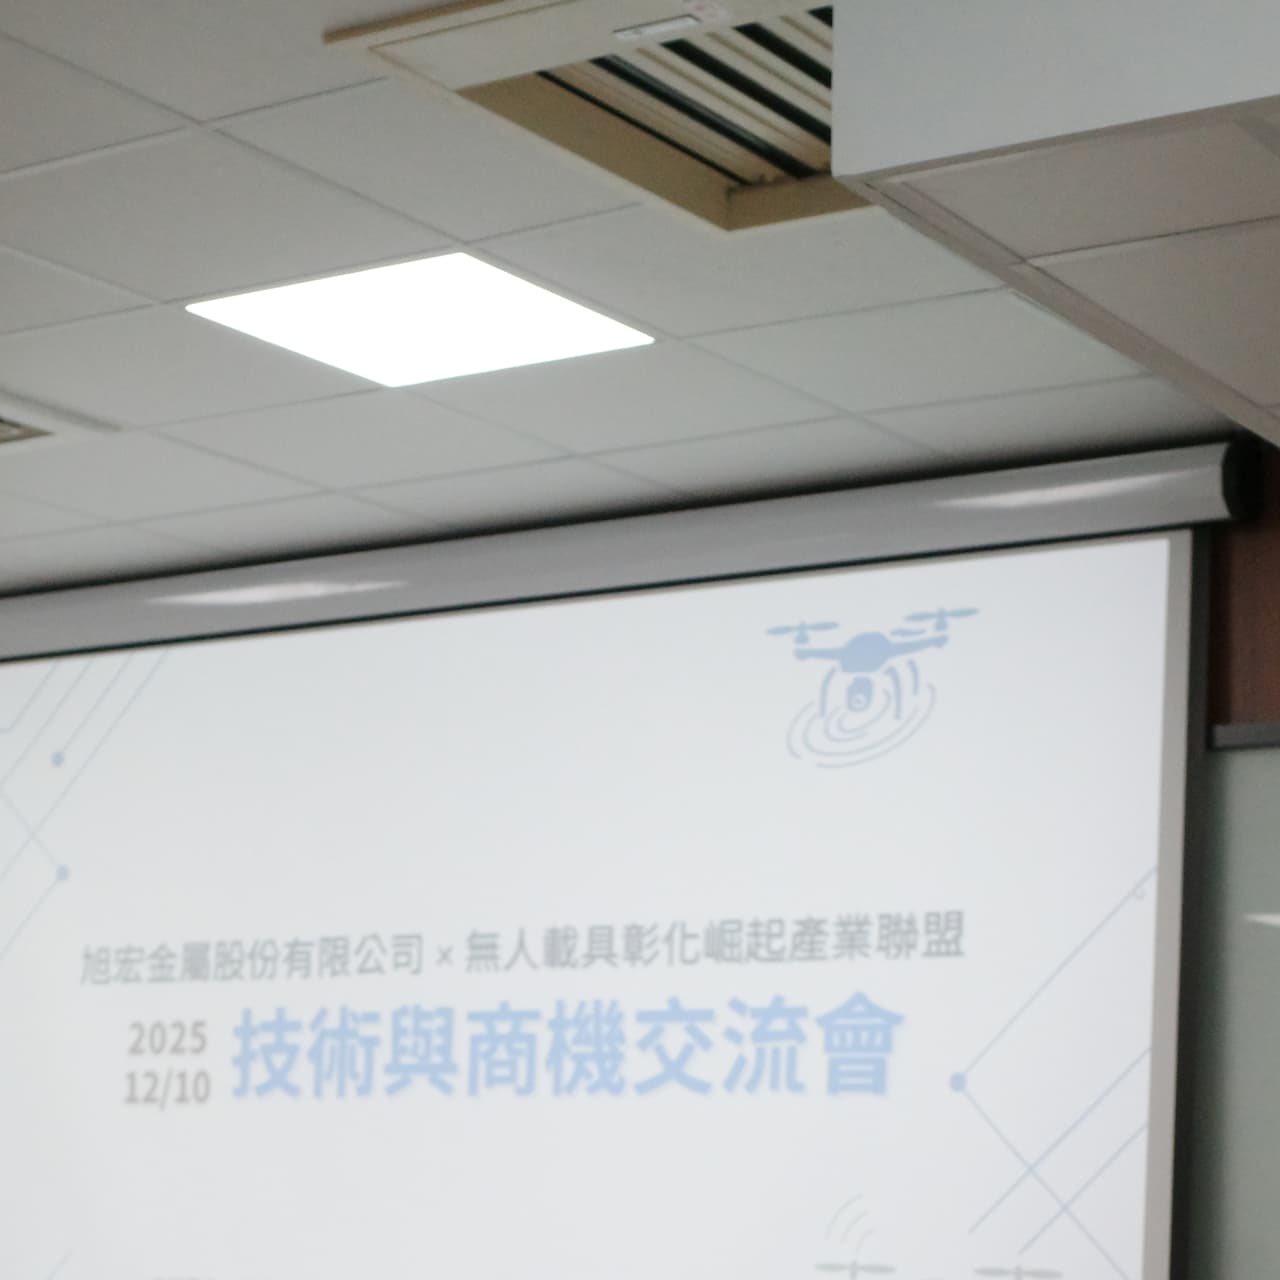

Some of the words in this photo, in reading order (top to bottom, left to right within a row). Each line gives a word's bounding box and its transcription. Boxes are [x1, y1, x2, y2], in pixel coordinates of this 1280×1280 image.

[80, 932, 424, 986] 旭宏金屬股份有限公司
[465, 910, 966, 974] 無人載具彰化崛起產業聯盟
[127, 1020, 208, 1057] 2025
[232, 991, 905, 1099] 技術與商機交流會
[124, 1068, 211, 1110] 12/10
